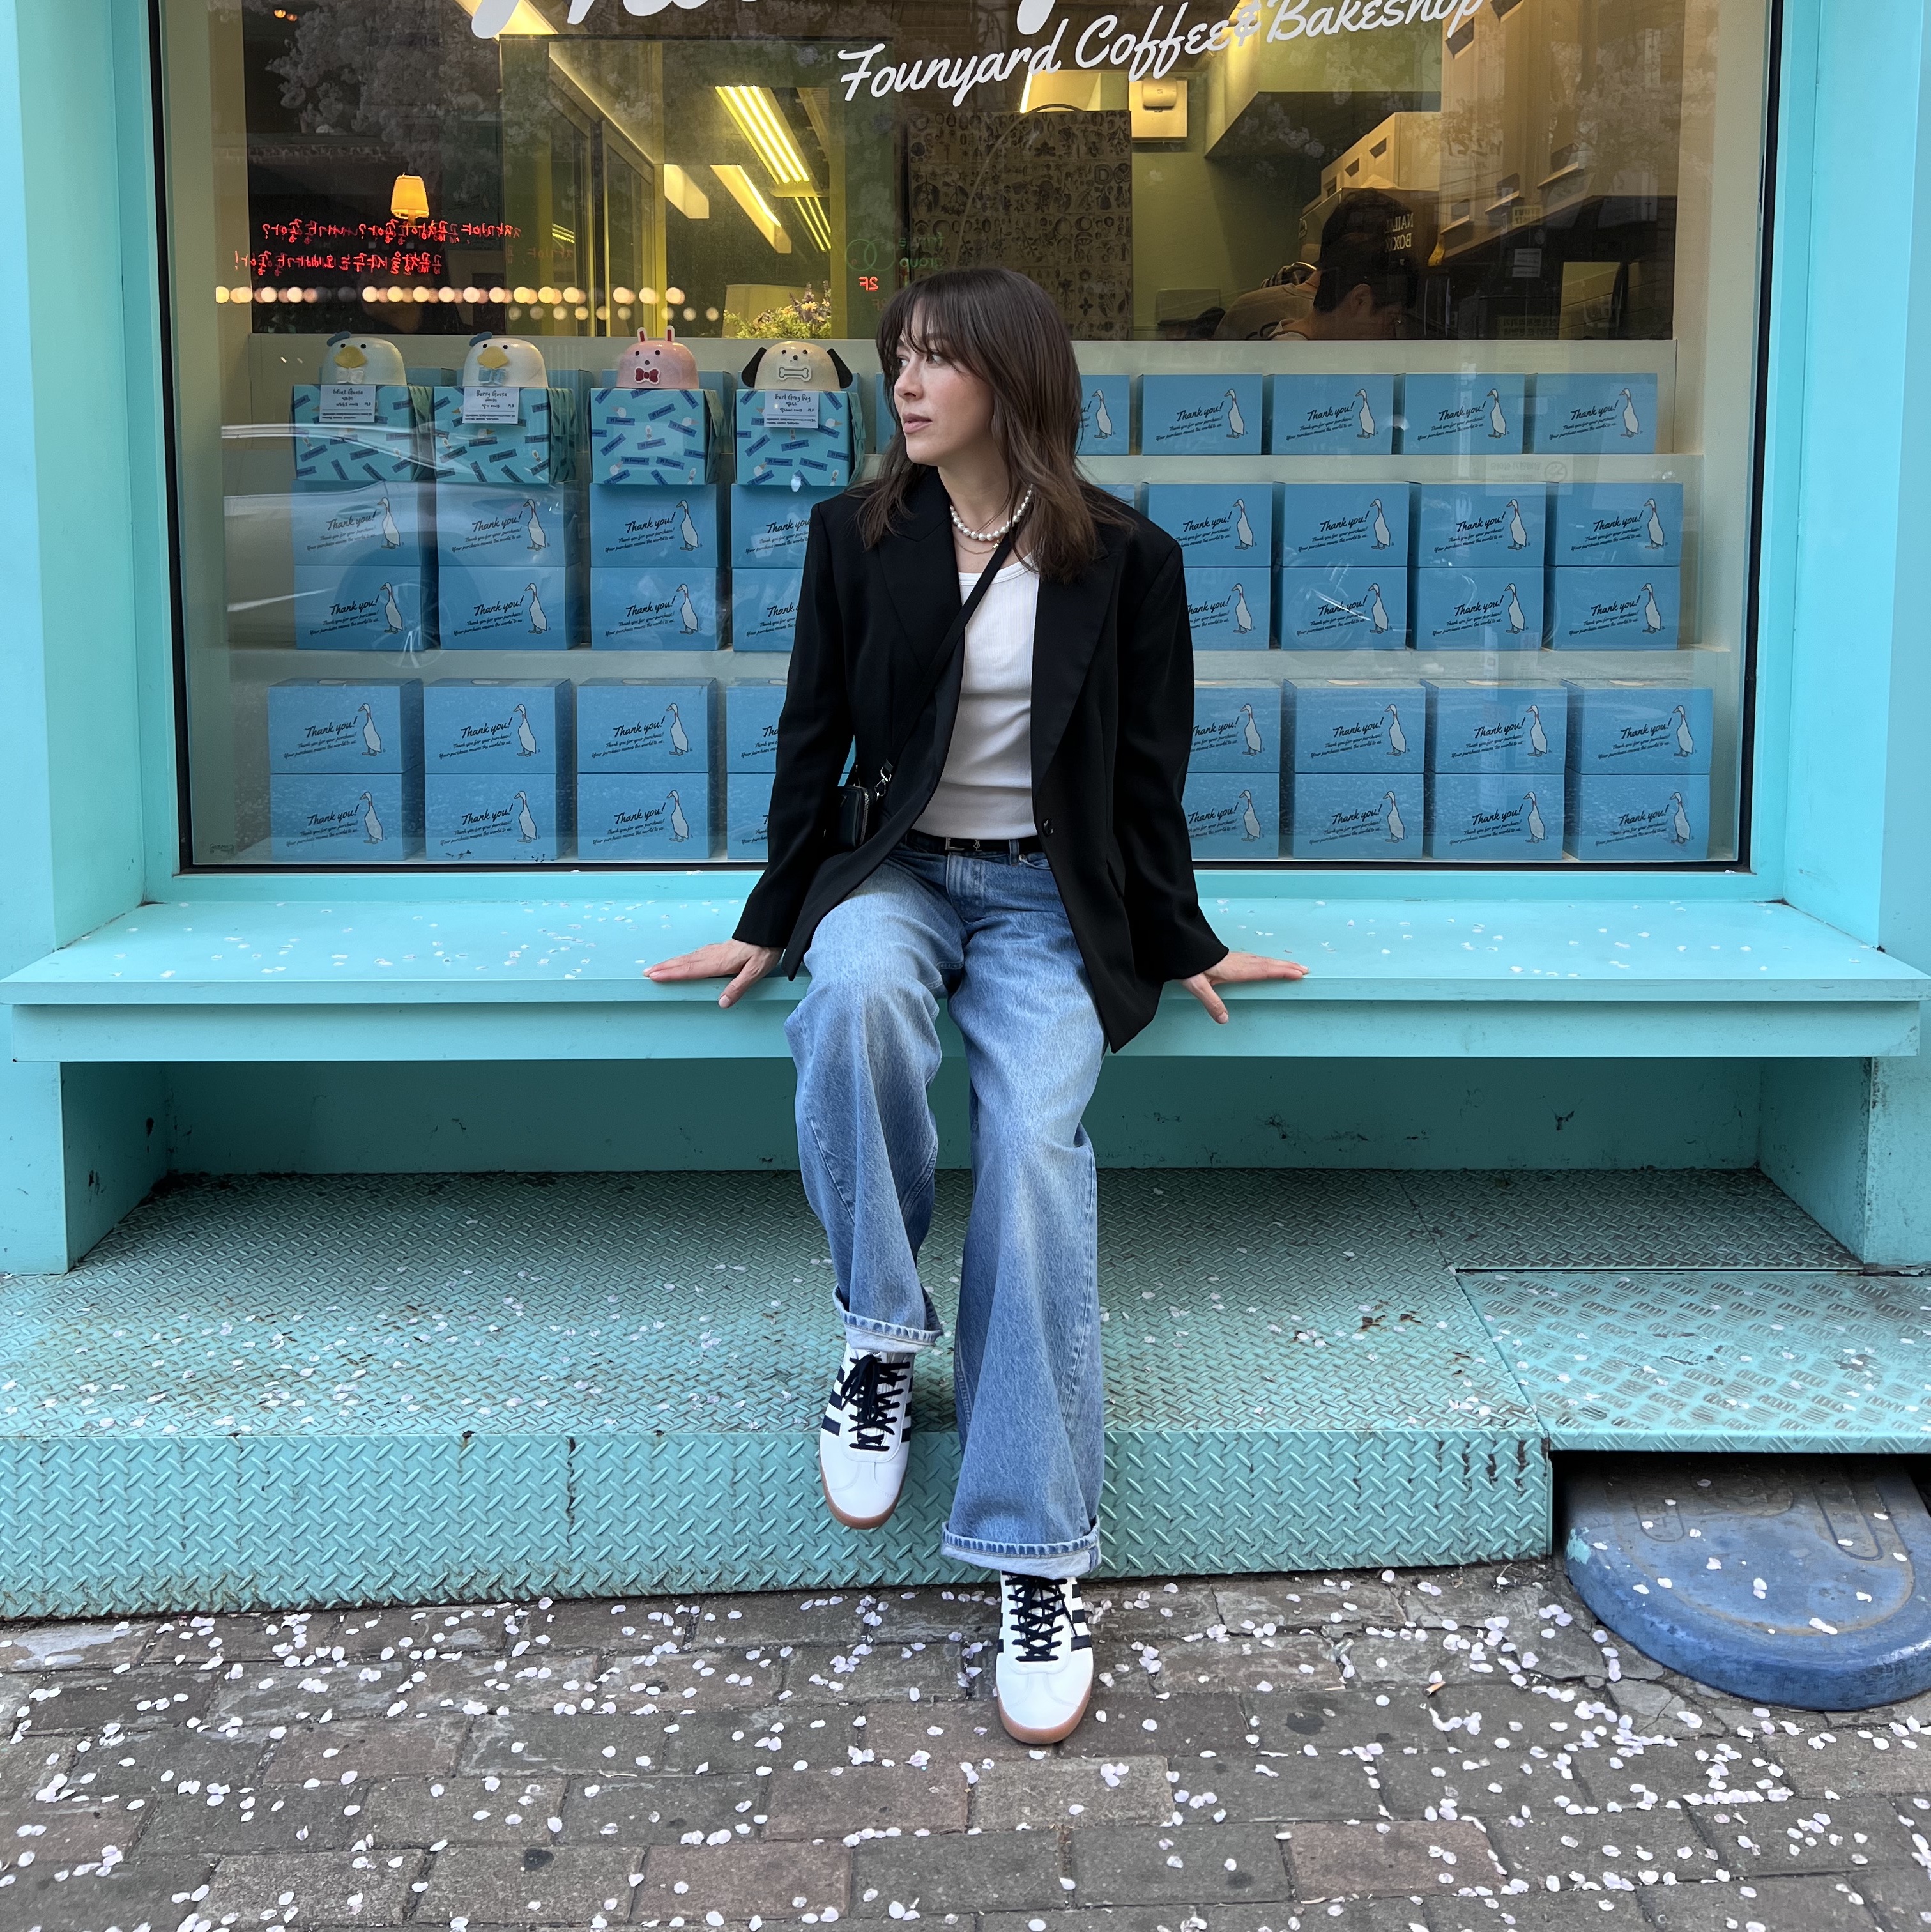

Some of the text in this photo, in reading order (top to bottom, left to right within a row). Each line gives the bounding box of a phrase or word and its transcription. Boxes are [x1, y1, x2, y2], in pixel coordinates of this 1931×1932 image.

[838, 19, 1062, 107] Founyard
[1175, 401, 1224, 422] Thank you!
[1306, 401, 1355, 421] Thank you!
[1438, 401, 1486, 421] Thank you!
[1569, 399, 1619, 420] Thank you!
[326, 510, 377, 531] Thank you!
[471, 511, 523, 532] Thank you!
[625, 512, 676, 533] Thank you!
[766, 519, 794, 534] Thank
[1182, 511, 1232, 532] Thank you!
[1319, 511, 1370, 532] Thank you!
[1455, 511, 1506, 533] Thank you!
[1592, 510, 1644, 532] Thank you!
[329, 595, 379, 616] Thank you!
[473, 595, 524, 616] Thank you!
[625, 596, 676, 617] Thank you!
[767, 602, 795, 617] Thank
[1210, 595, 1231, 613] you!
[1317, 595, 1368, 617] Thank you!
[1453, 595, 1504, 617] Thank you!
[1591, 595, 1641, 616] Thank you!
[305, 716, 358, 738] Thank you!
[460, 717, 513, 739] Thank you!
[613, 716, 666, 738] Thank you!
[763, 725, 778, 738] Tha
[1218, 716, 1240, 735] you!
[1332, 717, 1384, 738] Thank you!
[1474, 717, 1526, 739] Thank you!
[1620, 718, 1672, 739] Thank you!
[307, 804, 359, 826] Thank you!
[461, 804, 514, 825] Thank you!
[614, 802, 666, 825] Thank you!
[1187, 802, 1239, 824] Thank you!
[1331, 804, 1383, 825] Thank you!
[1471, 804, 1523, 825] Thank you!
[1617, 804, 1670, 826] Thank you!
